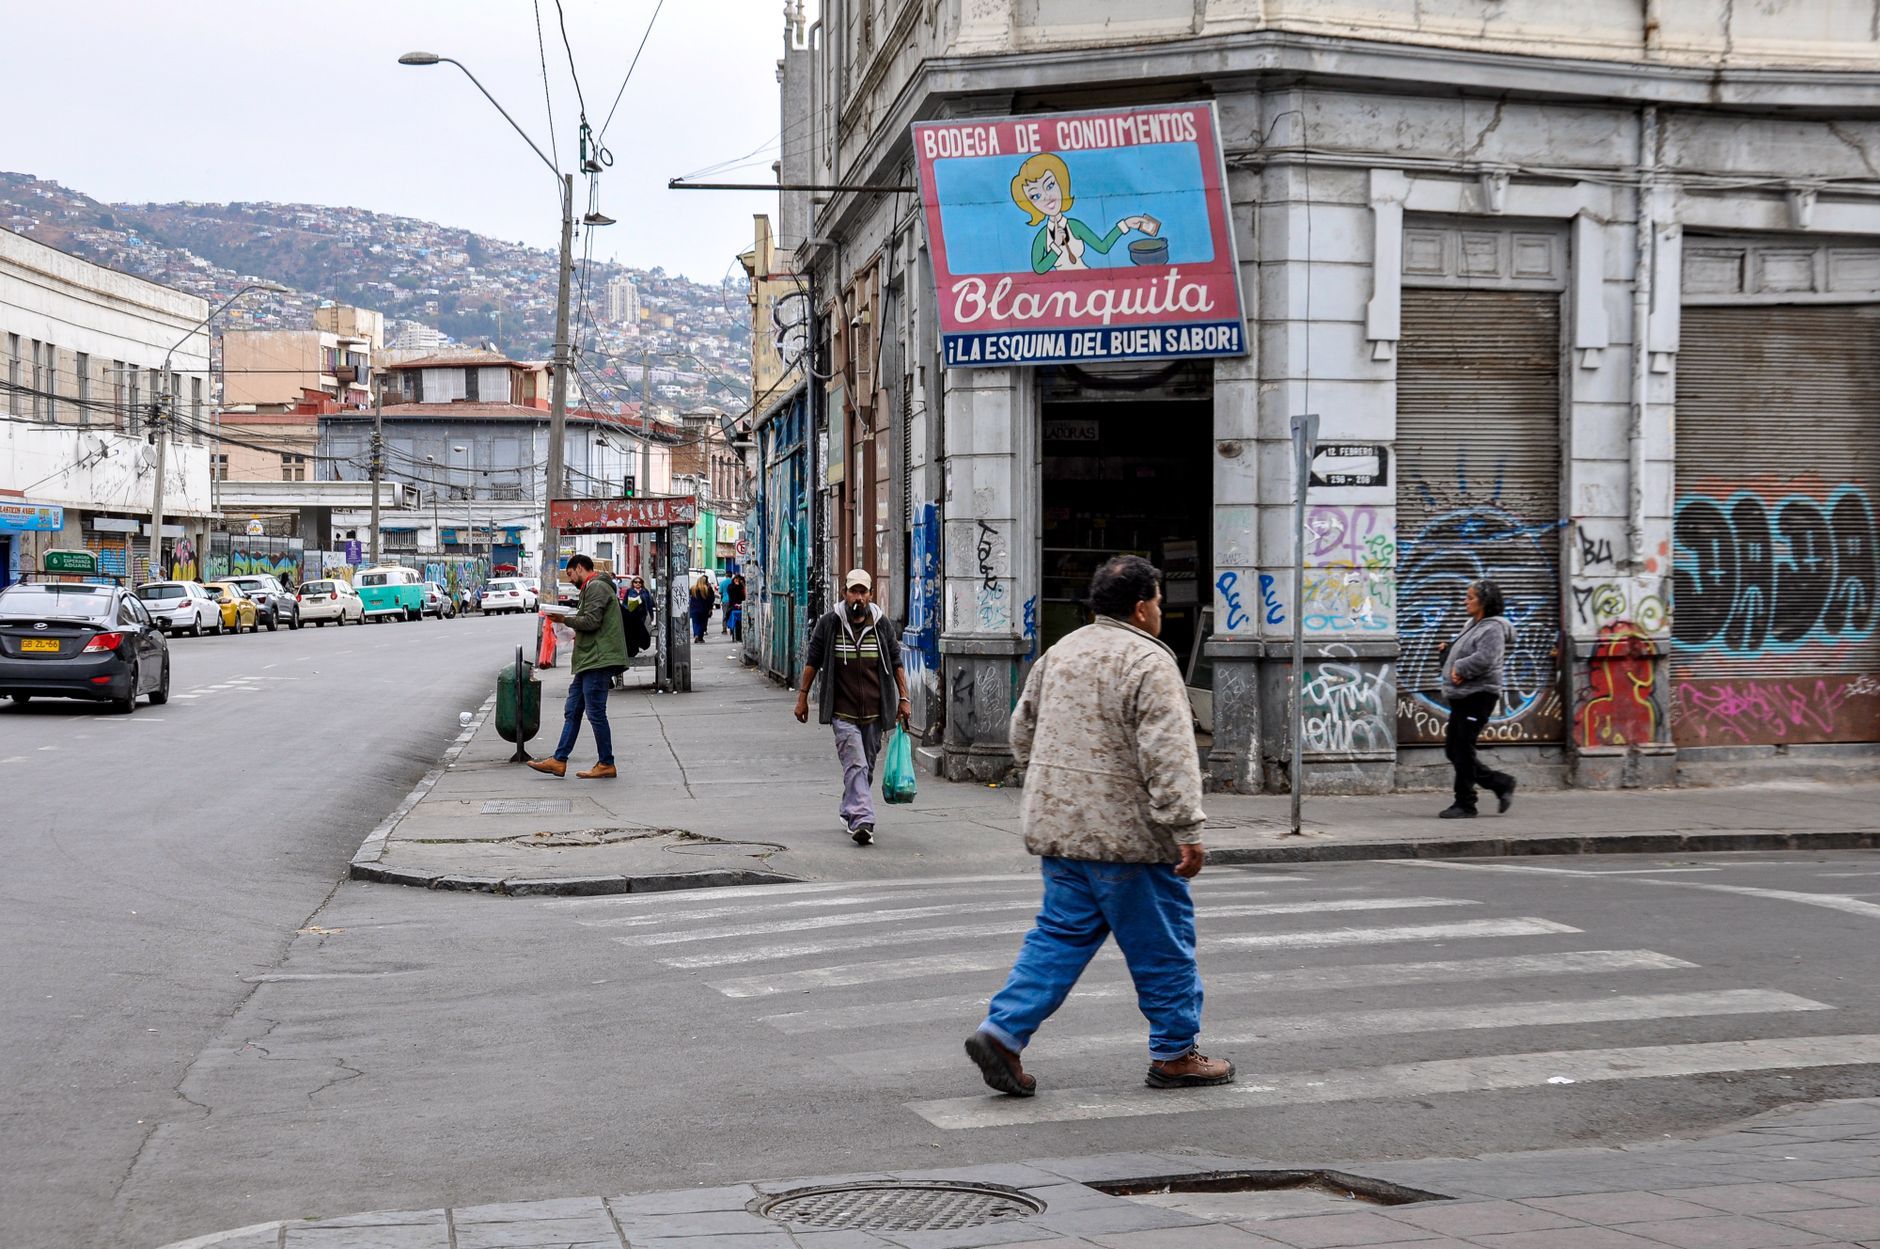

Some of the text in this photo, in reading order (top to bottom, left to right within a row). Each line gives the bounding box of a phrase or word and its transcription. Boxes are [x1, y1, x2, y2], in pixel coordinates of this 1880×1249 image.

[923, 111, 1198, 159] BODEGA DE CONDIMENTOS
[951, 267, 1215, 325] Blanquita
[984, 332, 1066, 362] ESQUINA
[1070, 331, 1107, 357] DEL
[1110, 328, 1163, 354] BUEN
[1165, 325, 1239, 352] SABOR!
[1328, 447, 1373, 456] 12 FEBRERO
[1414, 712, 1450, 737] POC
